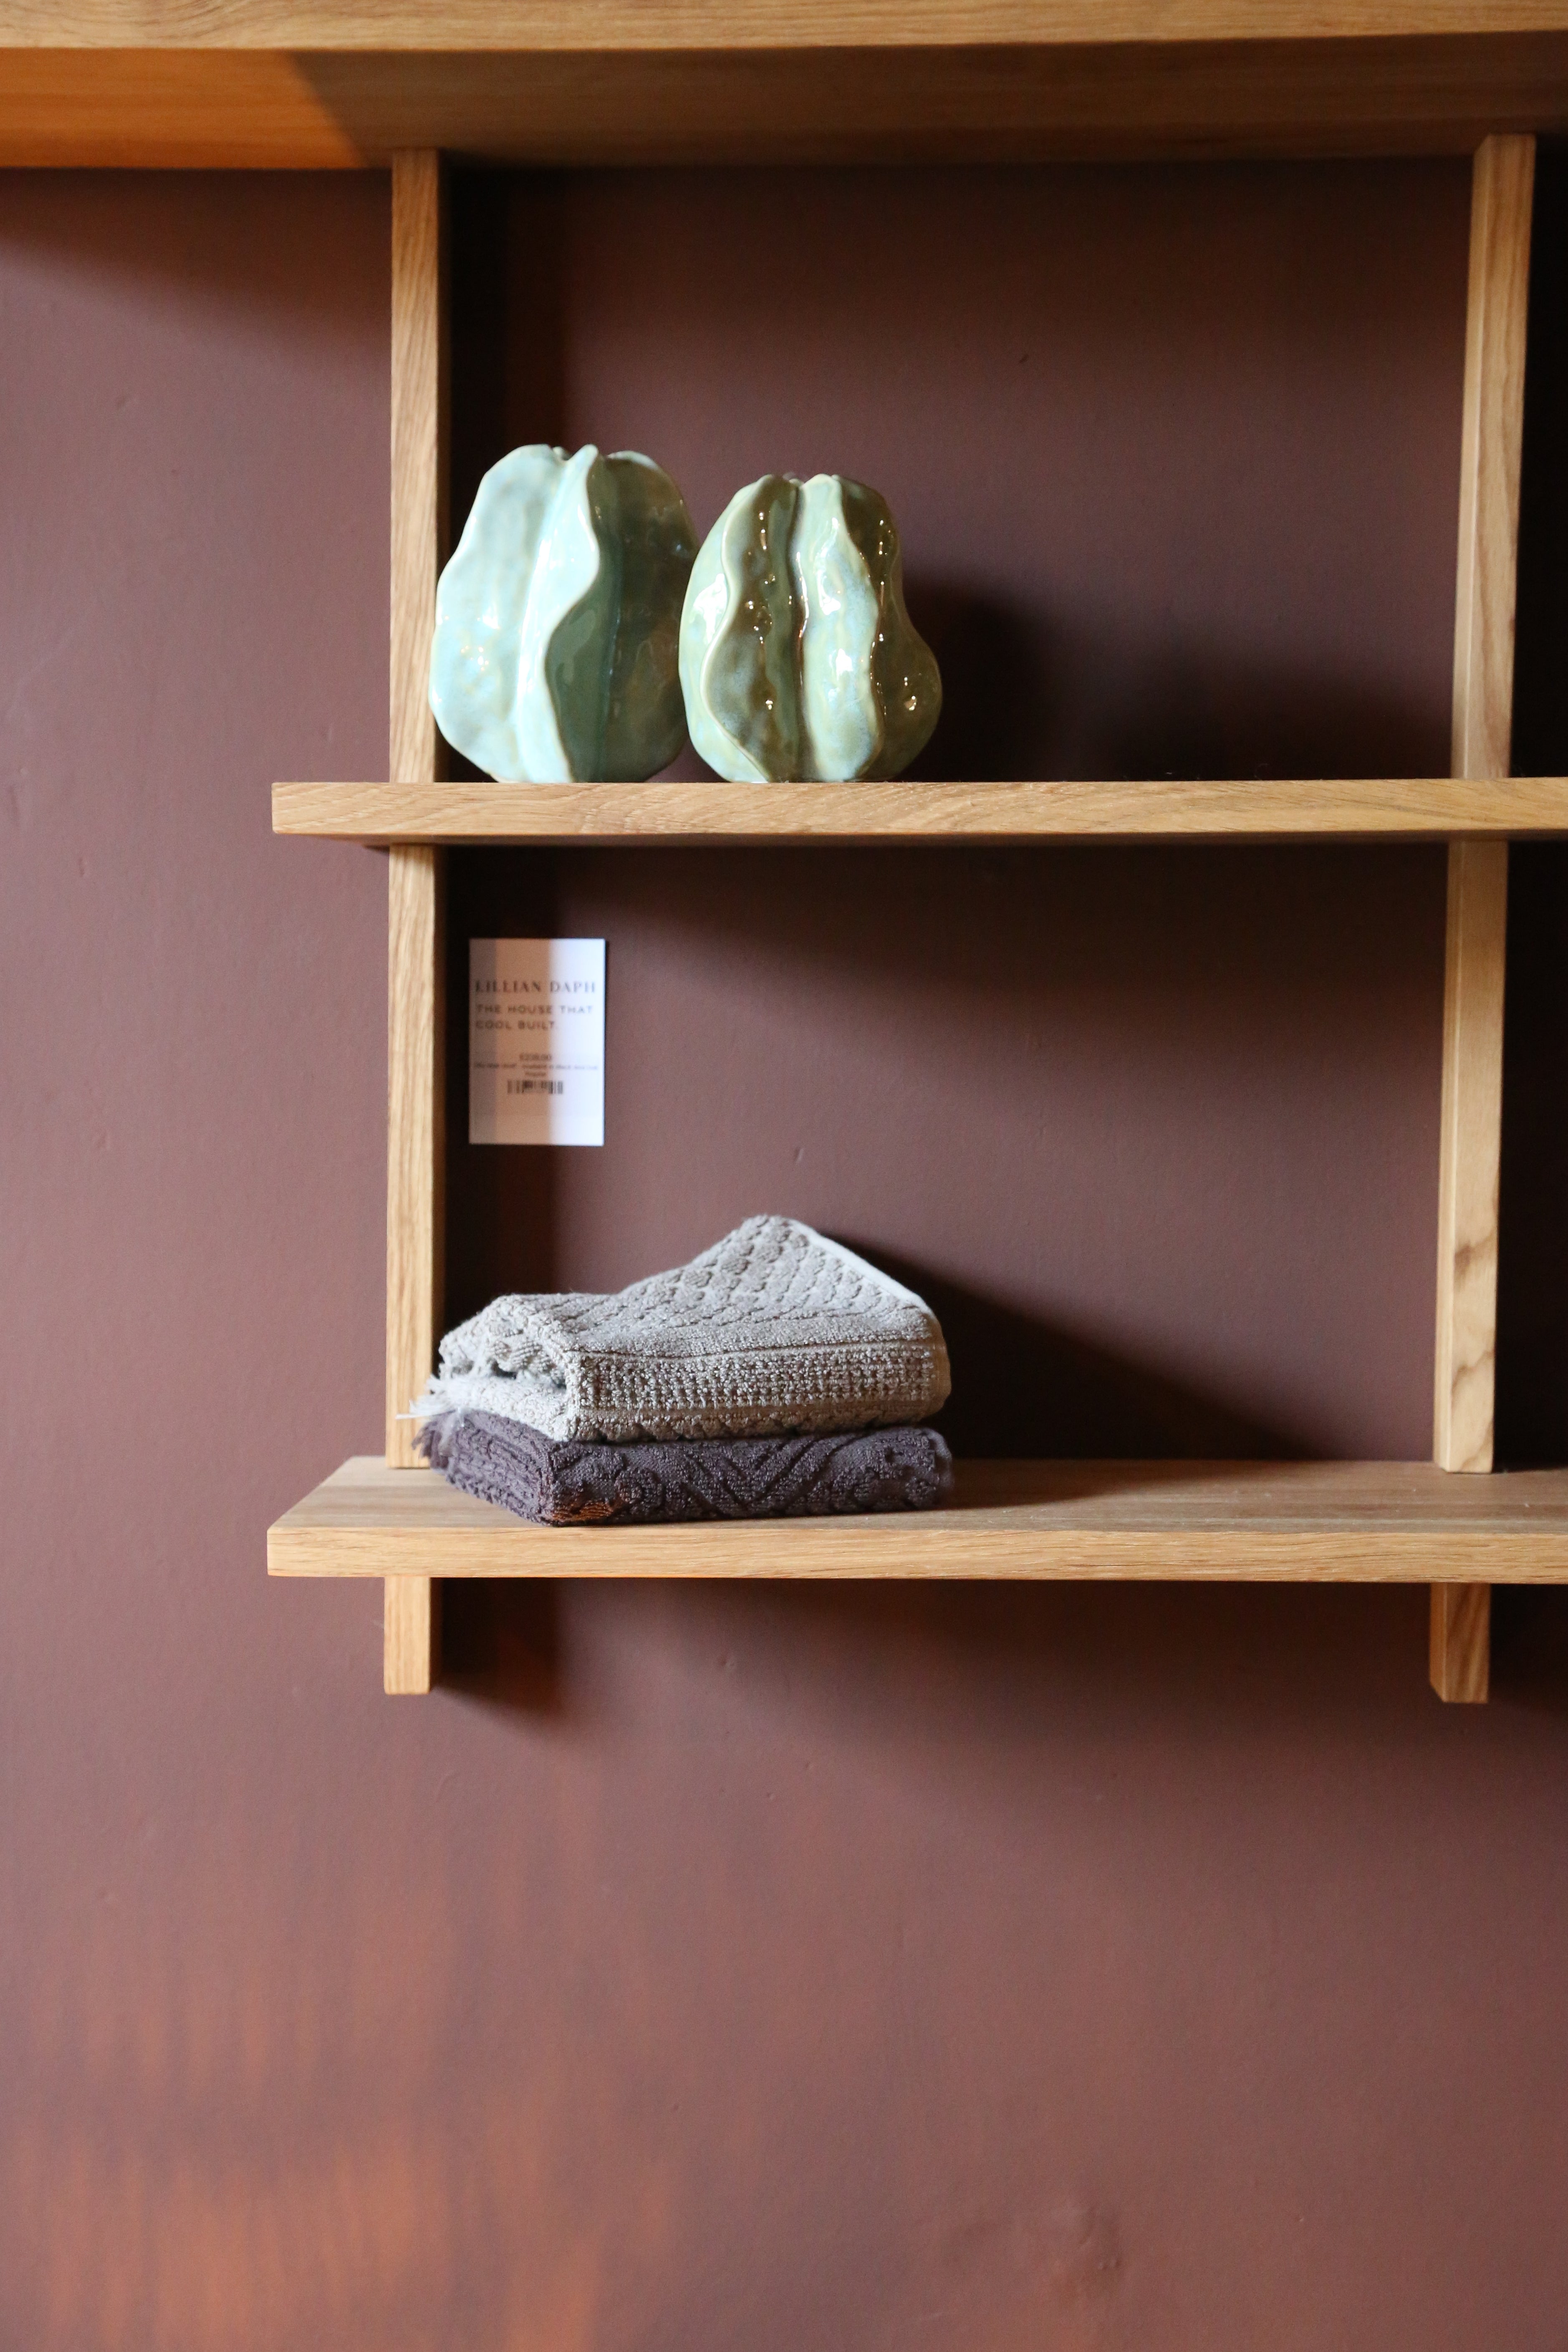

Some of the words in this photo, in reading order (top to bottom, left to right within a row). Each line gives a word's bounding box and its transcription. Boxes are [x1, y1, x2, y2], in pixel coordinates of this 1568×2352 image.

[475, 980, 542, 993] LILLIAN
[477, 1004, 501, 1014] THE
[507, 1004, 553, 1015] HOUSE
[559, 1005, 593, 1014] THAT
[475, 1020, 512, 1030] COOL
